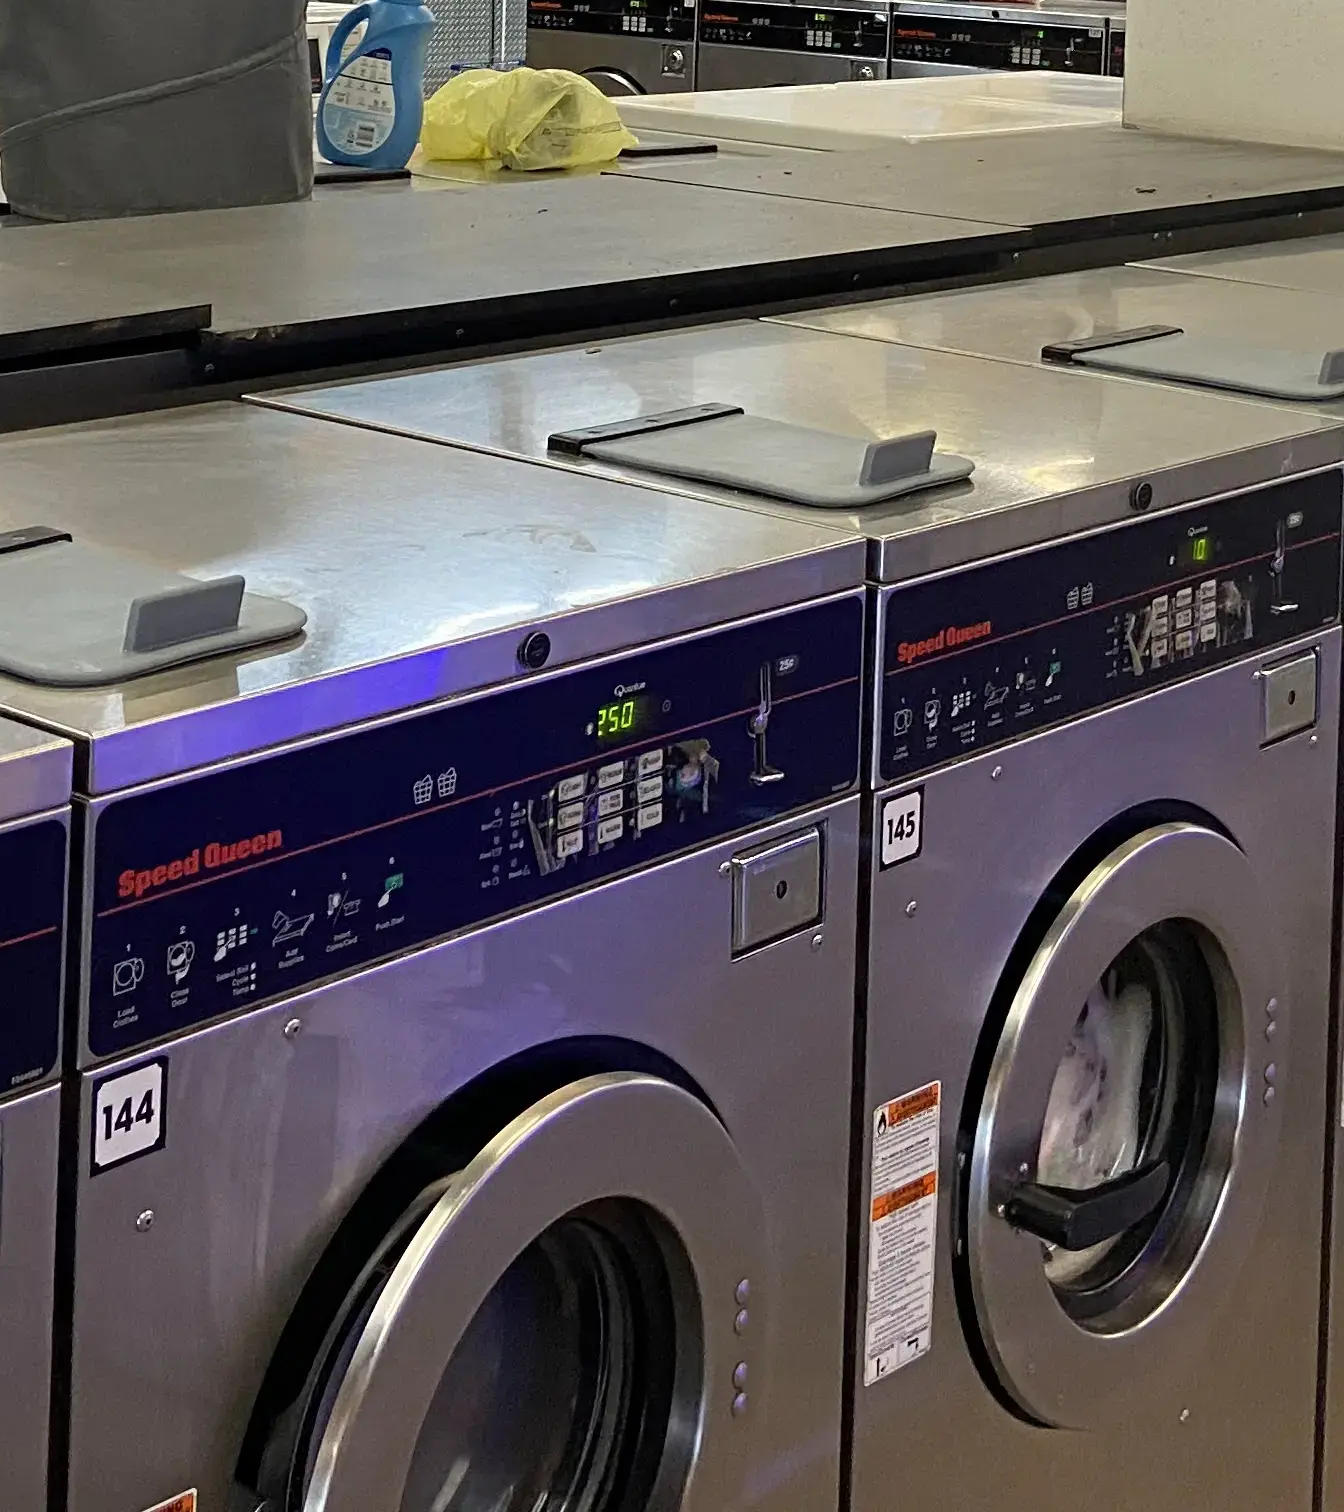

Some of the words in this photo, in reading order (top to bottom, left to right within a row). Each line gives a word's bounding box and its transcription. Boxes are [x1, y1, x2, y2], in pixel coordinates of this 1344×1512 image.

[897, 629, 945, 664] Speed
[946, 619, 992, 646] Queen
[597, 700, 635, 737] 250
[887, 809, 916, 845] 145
[117, 849, 199, 899] Speed
[204, 828, 283, 869] Queen
[102, 1088, 155, 1141] 144
